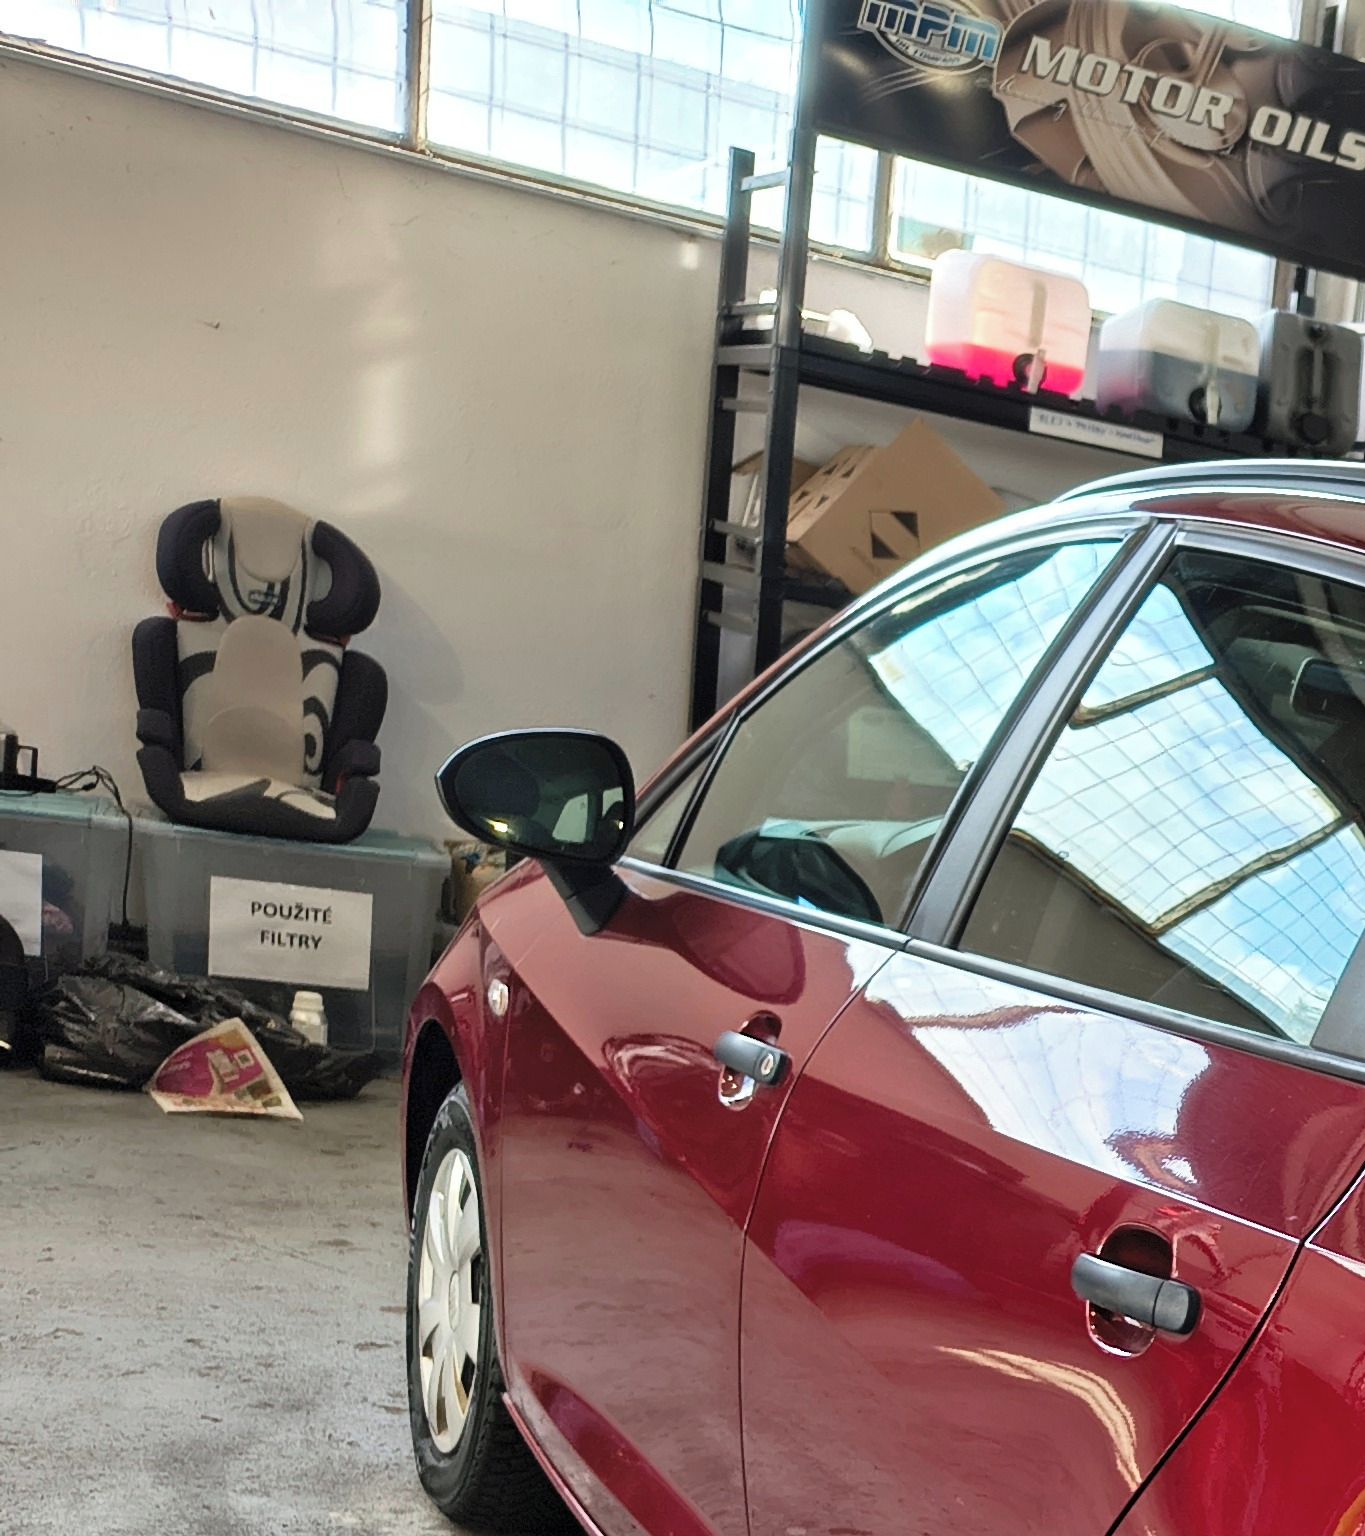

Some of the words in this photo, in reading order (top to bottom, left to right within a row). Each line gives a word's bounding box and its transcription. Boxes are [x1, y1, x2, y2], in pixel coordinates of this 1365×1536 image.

[1022, 36, 1237, 132] MOTOR
[251, 901, 332, 924] POUŽITÉ
[260, 930, 322, 950] FILTRY
